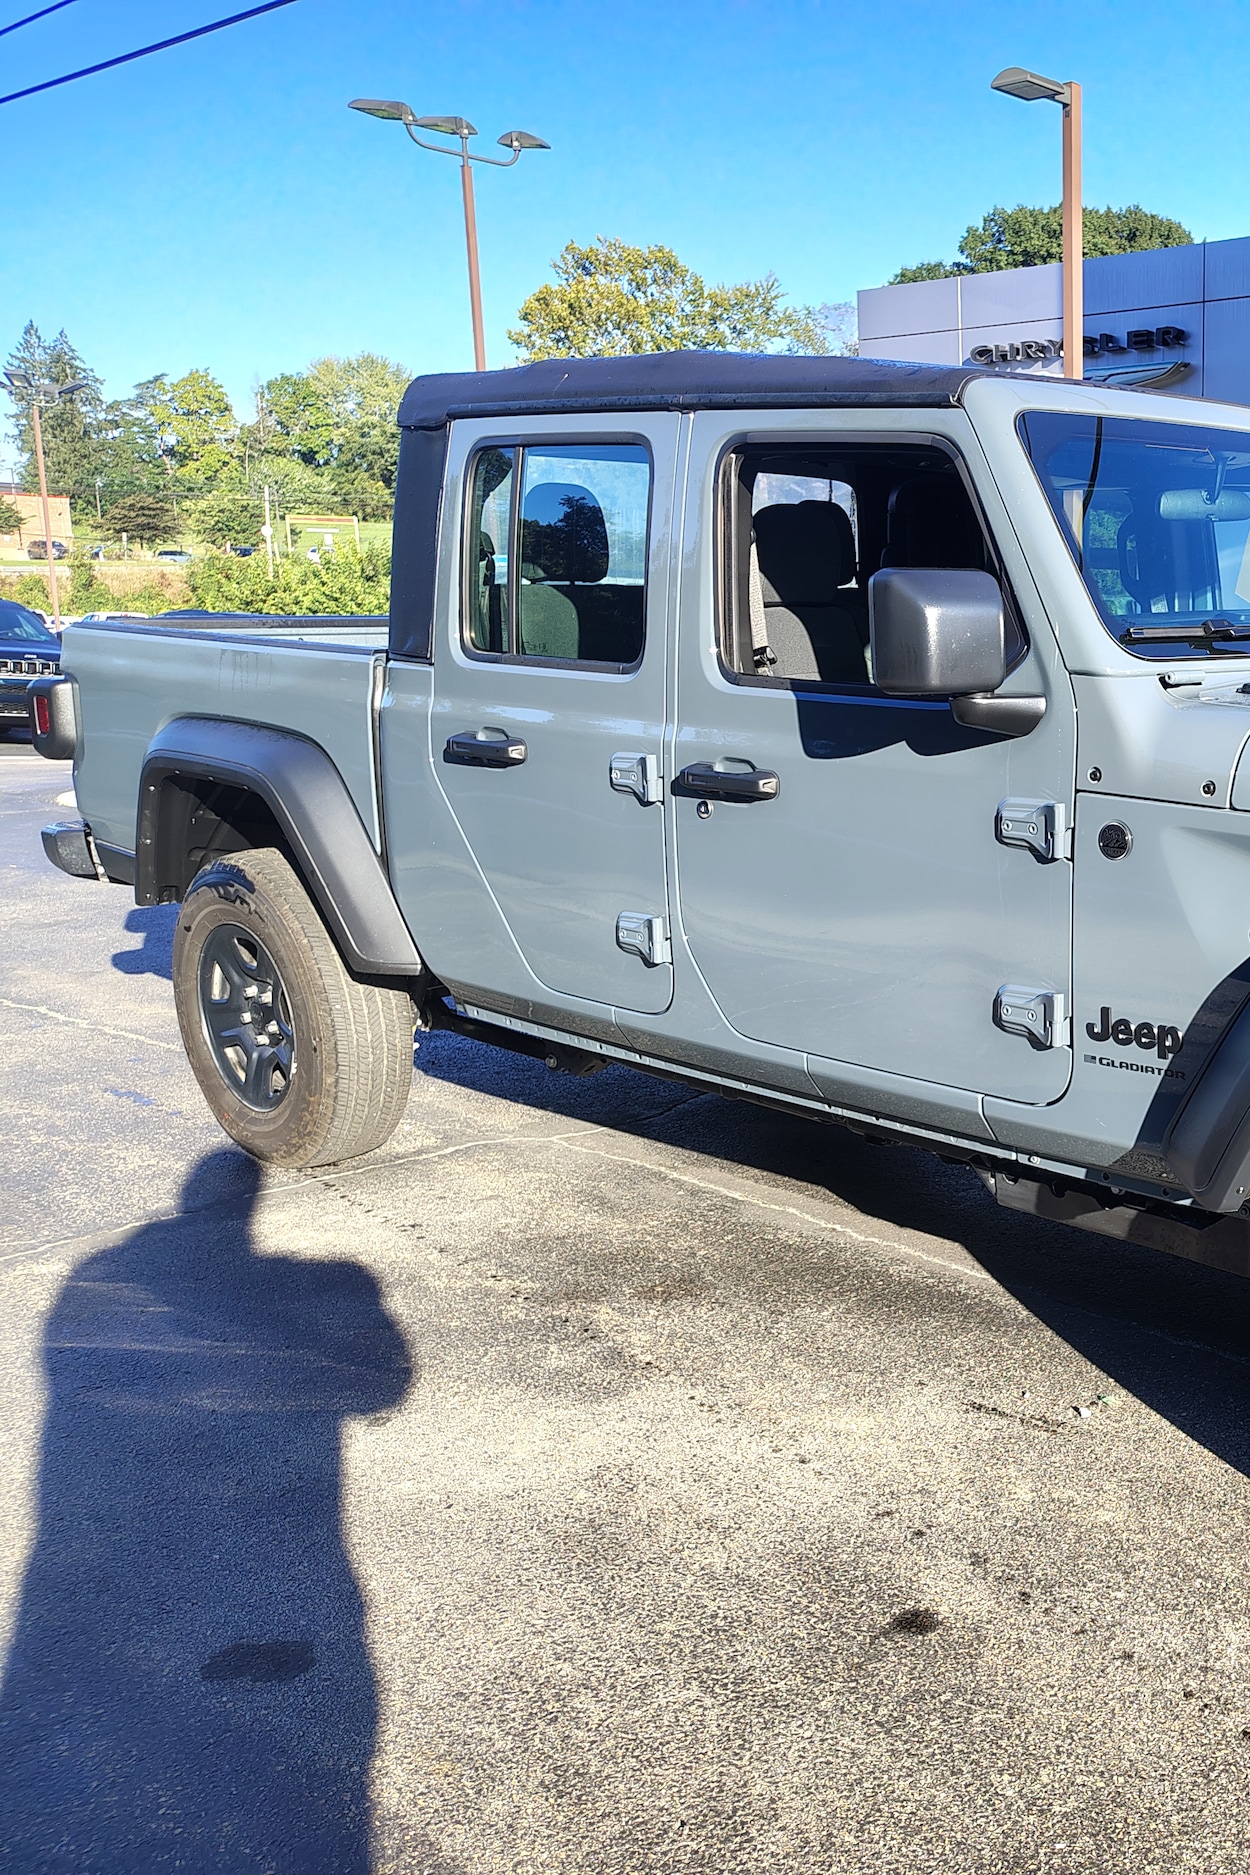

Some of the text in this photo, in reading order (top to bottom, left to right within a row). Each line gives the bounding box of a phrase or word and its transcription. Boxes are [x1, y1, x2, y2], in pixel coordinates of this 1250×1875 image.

[970, 326, 1187, 364] CHRYSLER
[1086, 1006, 1184, 1060] Jeep
[1099, 1057, 1187, 1081] GLADIATOR
